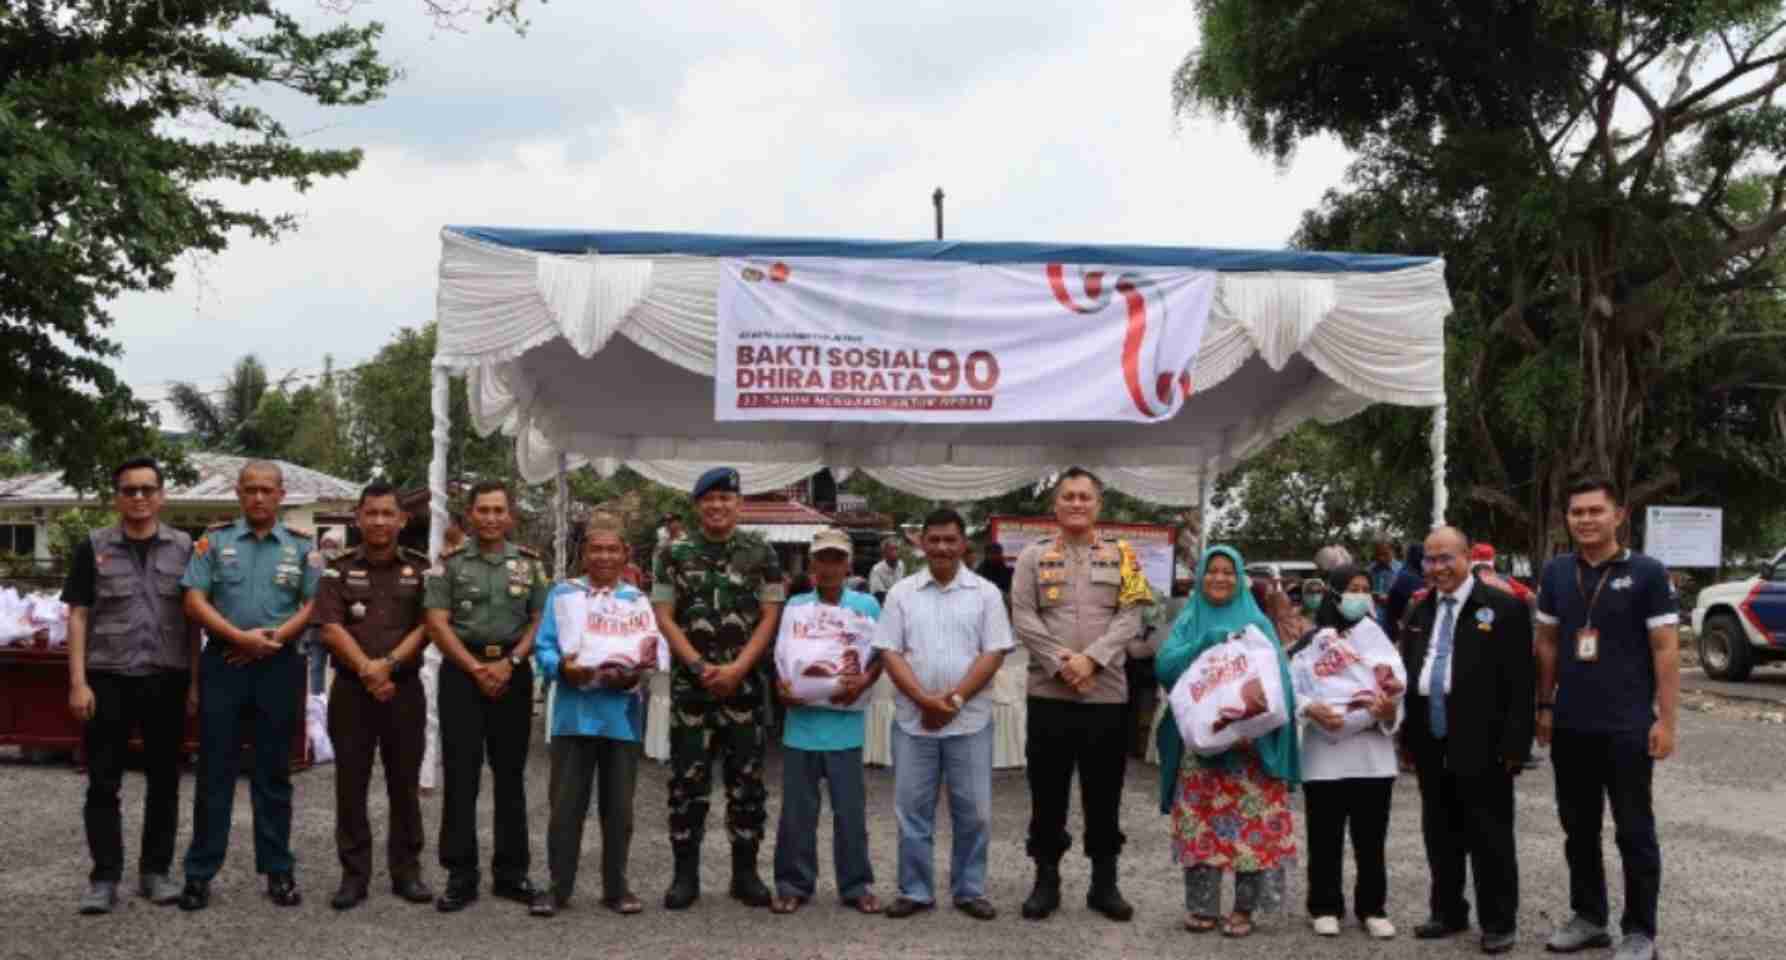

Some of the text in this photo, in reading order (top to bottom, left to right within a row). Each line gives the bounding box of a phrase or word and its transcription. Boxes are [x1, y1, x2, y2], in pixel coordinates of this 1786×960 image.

[737, 345, 925, 368] BAKTI SOSIAL
[736, 368, 926, 391] DHIRA BRATA
[928, 347, 999, 391] 90
